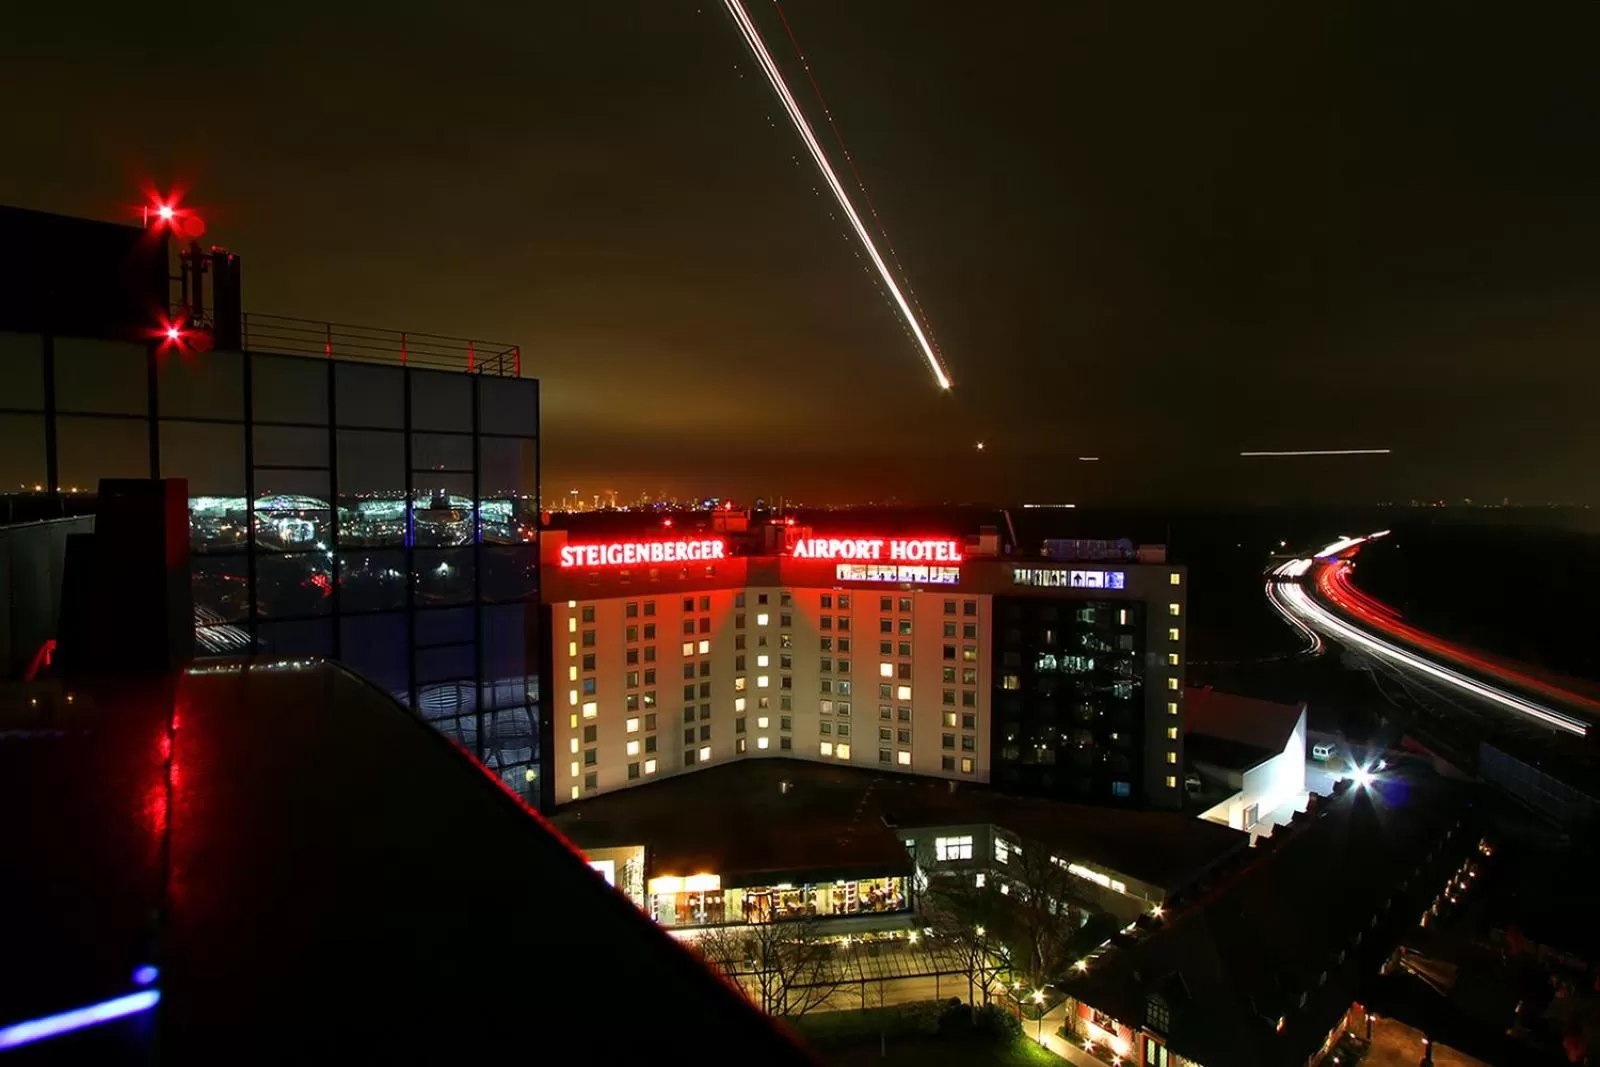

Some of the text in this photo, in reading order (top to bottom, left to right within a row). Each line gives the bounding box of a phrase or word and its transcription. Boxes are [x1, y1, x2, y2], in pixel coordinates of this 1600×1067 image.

[561, 540, 724, 567] STEIGENBERGER
[793, 539, 962, 561] AIRPORT HOTEL
